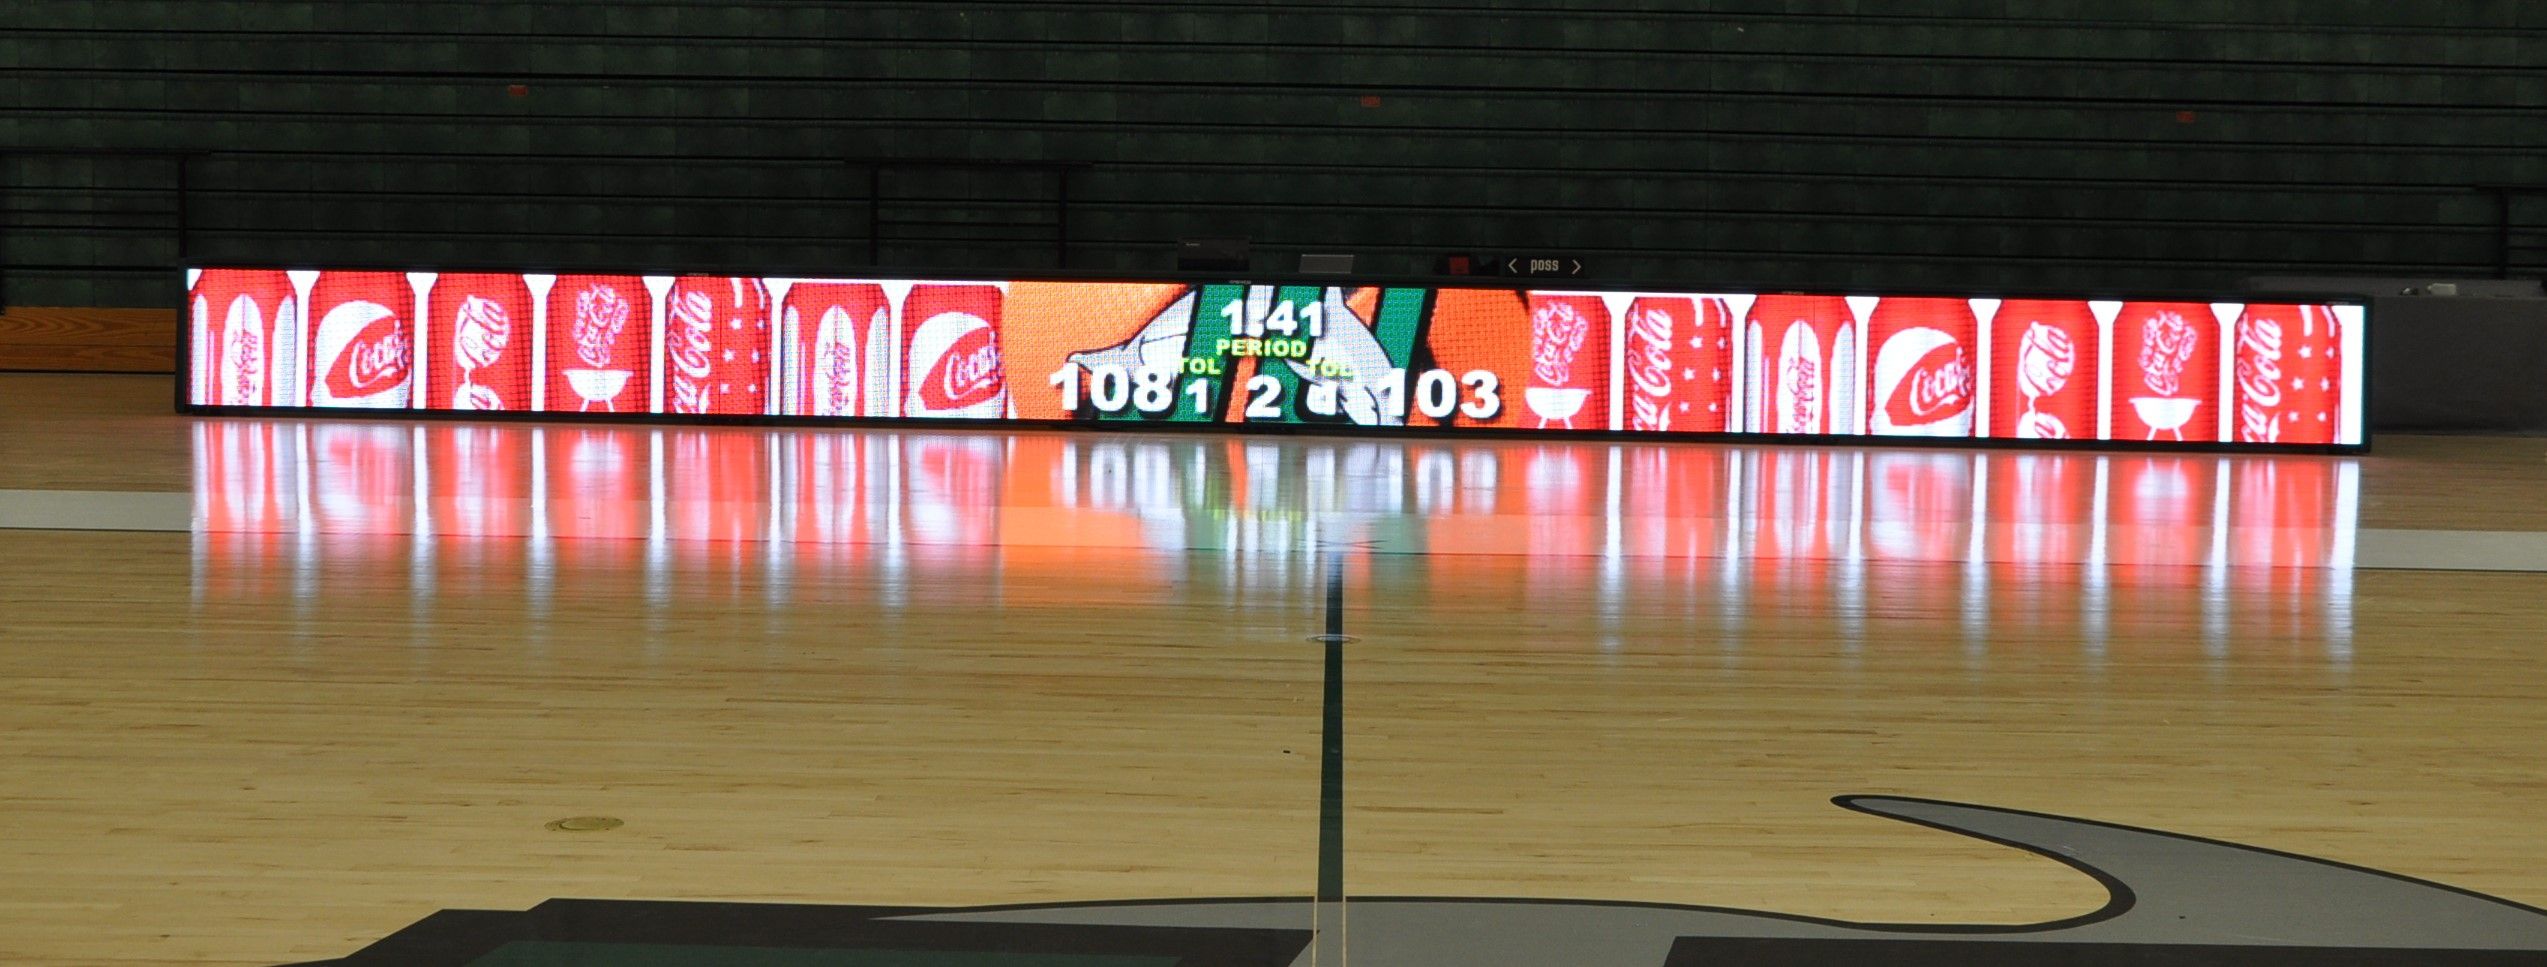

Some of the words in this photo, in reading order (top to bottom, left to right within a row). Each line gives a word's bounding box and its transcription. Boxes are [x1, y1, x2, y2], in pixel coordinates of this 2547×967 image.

[1531, 259, 1559, 274] poss
[1216, 338, 1306, 357] PERIOD
[1179, 358, 1221, 374] TOL
[1307, 358, 1354, 377] TOL
[1050, 362, 1173, 412] 108
[1186, 377, 1209, 413] 1
[1245, 375, 1282, 417] 2
[1377, 367, 1500, 419] 103
